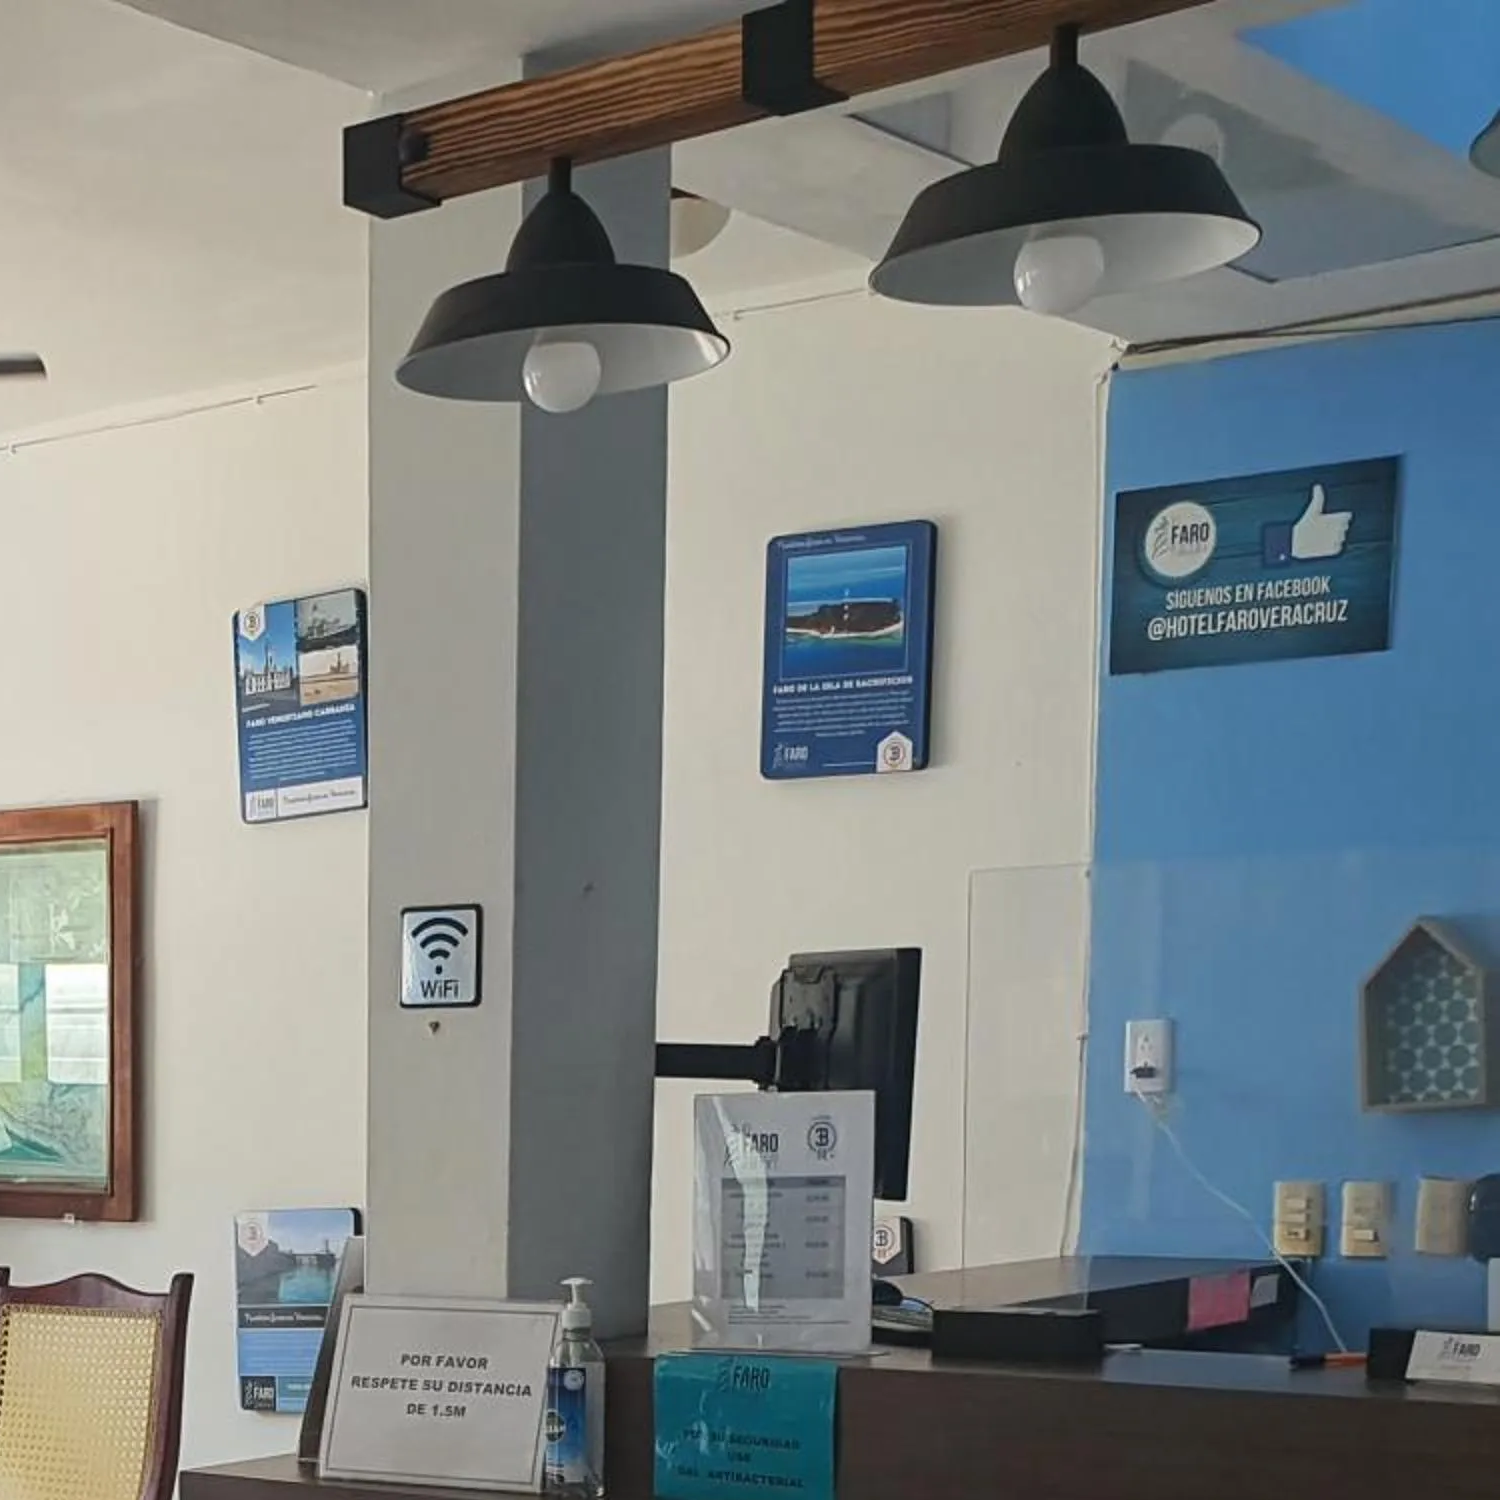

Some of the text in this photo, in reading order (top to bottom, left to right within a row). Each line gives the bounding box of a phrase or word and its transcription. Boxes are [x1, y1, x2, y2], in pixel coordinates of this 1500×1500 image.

[1171, 521, 1211, 545] FARO
[1235, 583, 1254, 603] EN
[1257, 575, 1332, 602] FACEBOOK
[1147, 599, 1349, 642] @HOTELFAROVERACRUZ
[400, 1353, 489, 1370] POR FAVOR
[351, 1375, 532, 1397] RESPETE SU DISTANCIA
[733, 1365, 770, 1392] FARO
[406, 1403, 466, 1417] DE 1.5M
